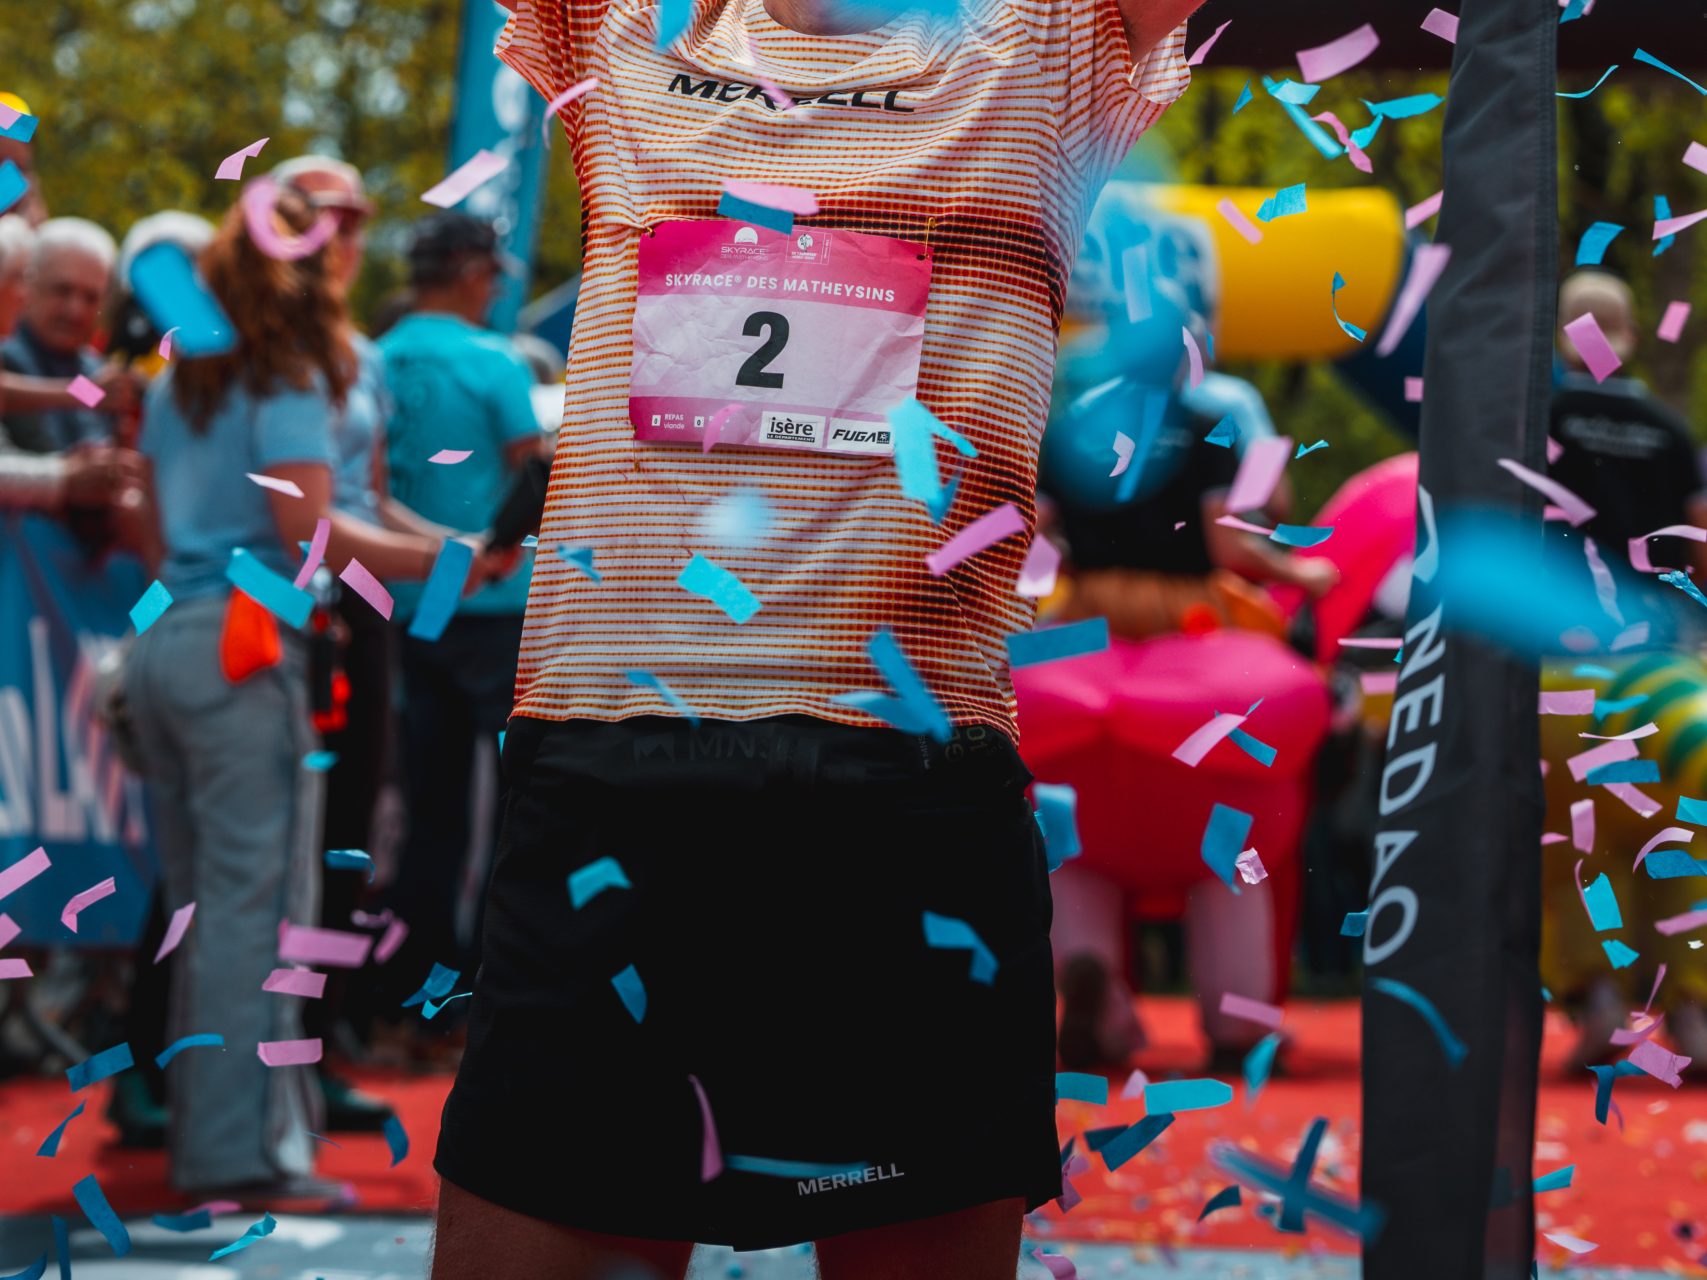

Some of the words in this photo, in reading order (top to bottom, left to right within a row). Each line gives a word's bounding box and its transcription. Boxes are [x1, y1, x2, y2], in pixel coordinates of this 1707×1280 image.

[721, 246, 767, 255] SKYRACE
[747, 275, 778, 291] DES
[783, 278, 896, 303] MATHEYSINS
[735, 310, 791, 390] 2
[664, 413, 685, 421] REPAS
[770, 417, 814, 436] isère
[832, 429, 877, 443] FUGA
[797, 1162, 905, 1196] MERRELL
